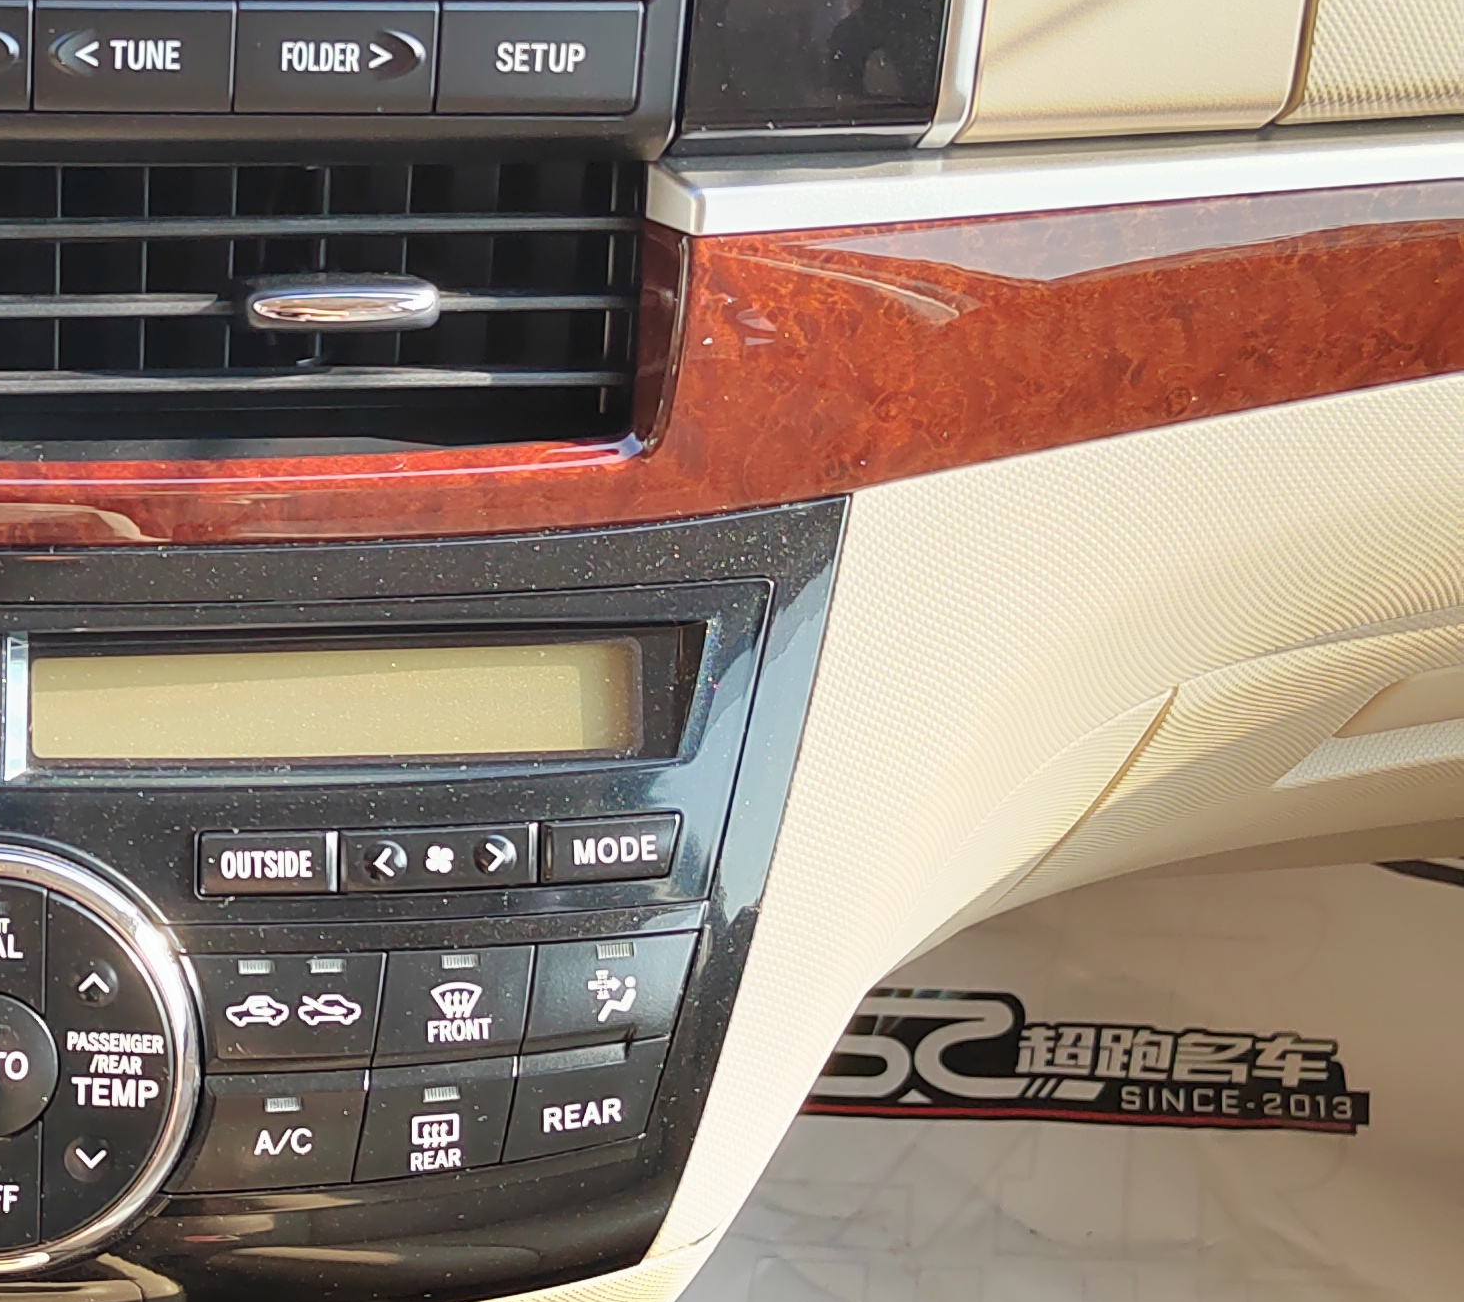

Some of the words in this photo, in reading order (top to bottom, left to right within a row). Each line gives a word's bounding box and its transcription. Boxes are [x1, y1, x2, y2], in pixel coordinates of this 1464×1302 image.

[109, 39, 182, 71] TUNE
[281, 40, 360, 73] FOLDER
[495, 42, 586, 73] SETUP
[220, 849, 313, 880] OUTSIDE
[572, 834, 663, 866] MODE
[66, 1031, 164, 1054] PASSENGER
[426, 1016, 493, 1043] FRONT
[89, 1056, 143, 1076] /REAR
[1017, 1024, 1336, 1087] 超跑名车
[71, 1077, 159, 1108] TEMP
[543, 1097, 622, 1133] REAR
[253, 1127, 313, 1156] A/C
[409, 1148, 462, 1173] REAR
